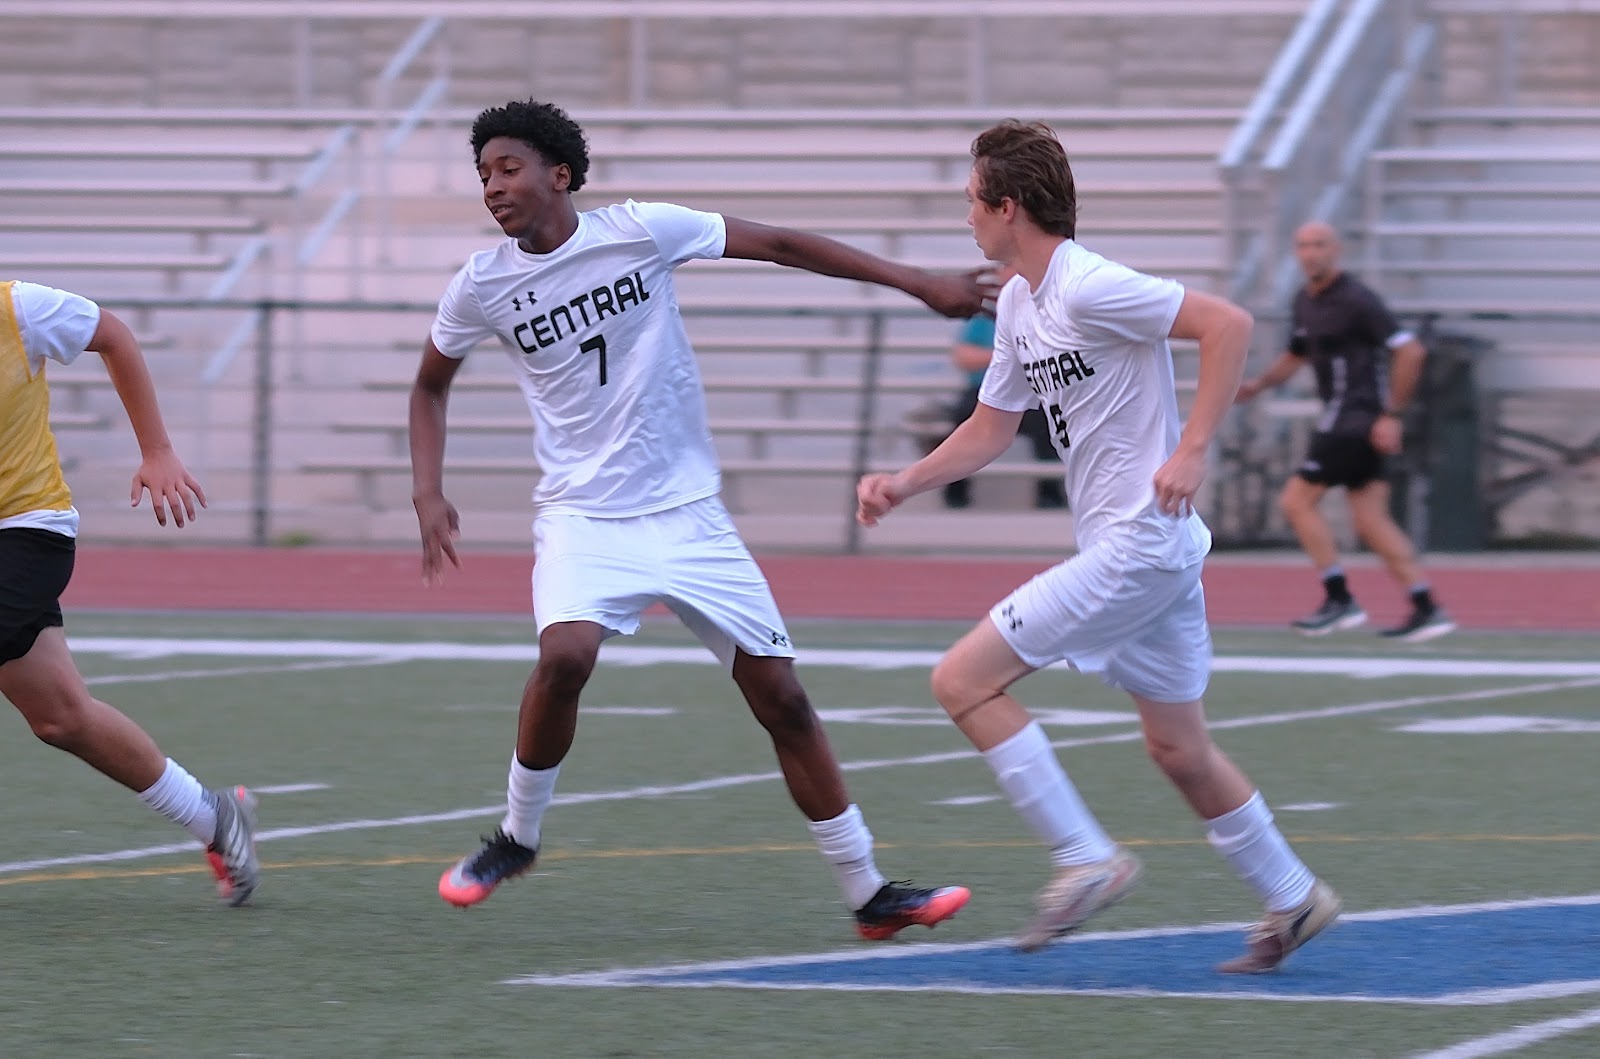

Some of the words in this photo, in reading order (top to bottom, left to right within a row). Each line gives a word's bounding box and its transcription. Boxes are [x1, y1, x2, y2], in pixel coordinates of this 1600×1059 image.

[513, 271, 650, 355] CENTRAL
[579, 333, 607, 387] 7
[1023, 350, 1095, 394] ENTRAL
[1049, 403, 1070, 449] 5
